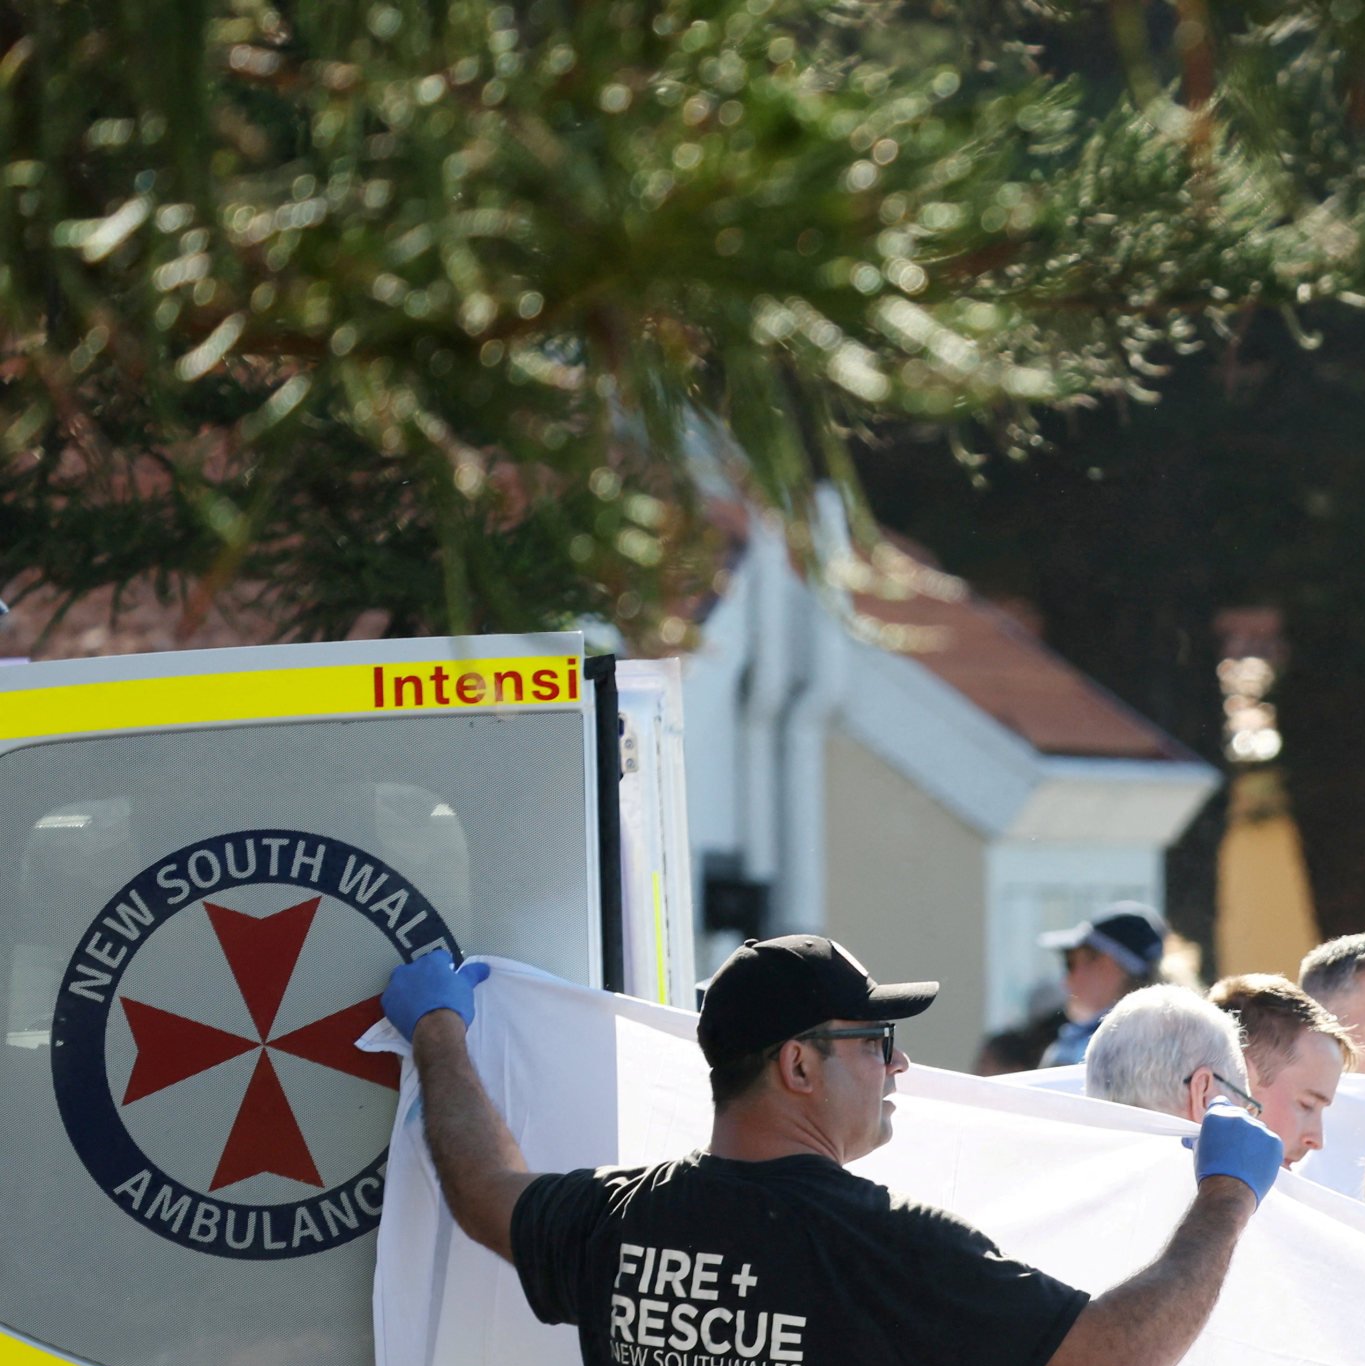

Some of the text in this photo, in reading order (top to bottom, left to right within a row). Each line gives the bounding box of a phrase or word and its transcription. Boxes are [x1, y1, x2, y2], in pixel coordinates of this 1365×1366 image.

[373, 658, 577, 708] Intensi
[68, 889, 150, 1003] NEW
[156, 838, 326, 905] SOUTH
[113, 1167, 386, 1251] AMBULANC
[614, 1243, 724, 1300] FIRE
[610, 1293, 806, 1361] RESCUE
